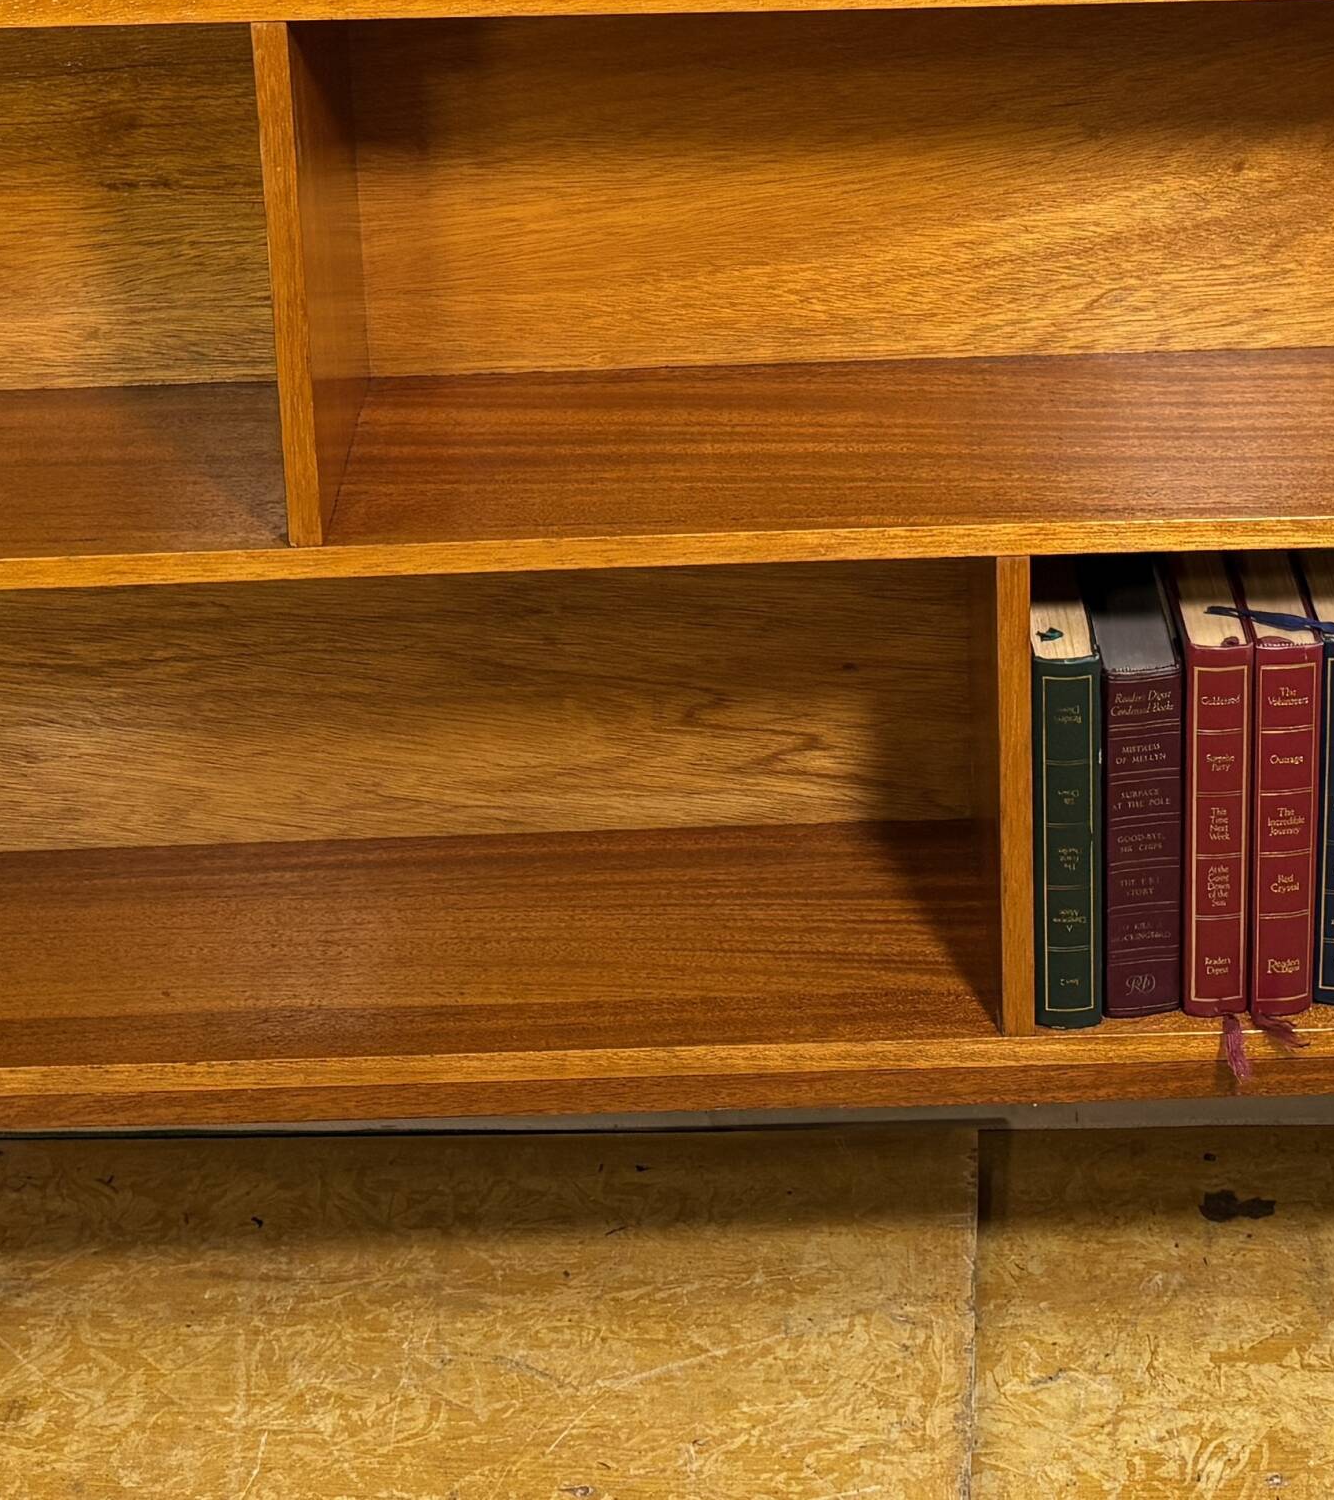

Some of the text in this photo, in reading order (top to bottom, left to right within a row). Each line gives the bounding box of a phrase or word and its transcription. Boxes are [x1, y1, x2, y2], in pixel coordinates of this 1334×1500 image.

[1279, 686, 1297, 697] The
[1115, 757, 1126, 765] OF
[1269, 754, 1304, 765] Outrage
[1128, 800, 1143, 810] THE
[1147, 797, 1170, 807] POLE
[1211, 806, 1227, 816] This
[1277, 806, 1295, 818] The
[1210, 815, 1228, 824] Time
[1267, 816, 1306, 827] Incredible
[1209, 824, 1228, 833] Next
[1209, 832, 1231, 841] Week
[1217, 865, 1229, 874] the
[1277, 874, 1295, 883] Red
[1207, 882, 1231, 891] Down
[1270, 883, 1300, 894] Crystal
[1217, 890, 1228, 900] the
[1212, 899, 1227, 907] Sun
[1206, 966, 1229, 976] Digest
